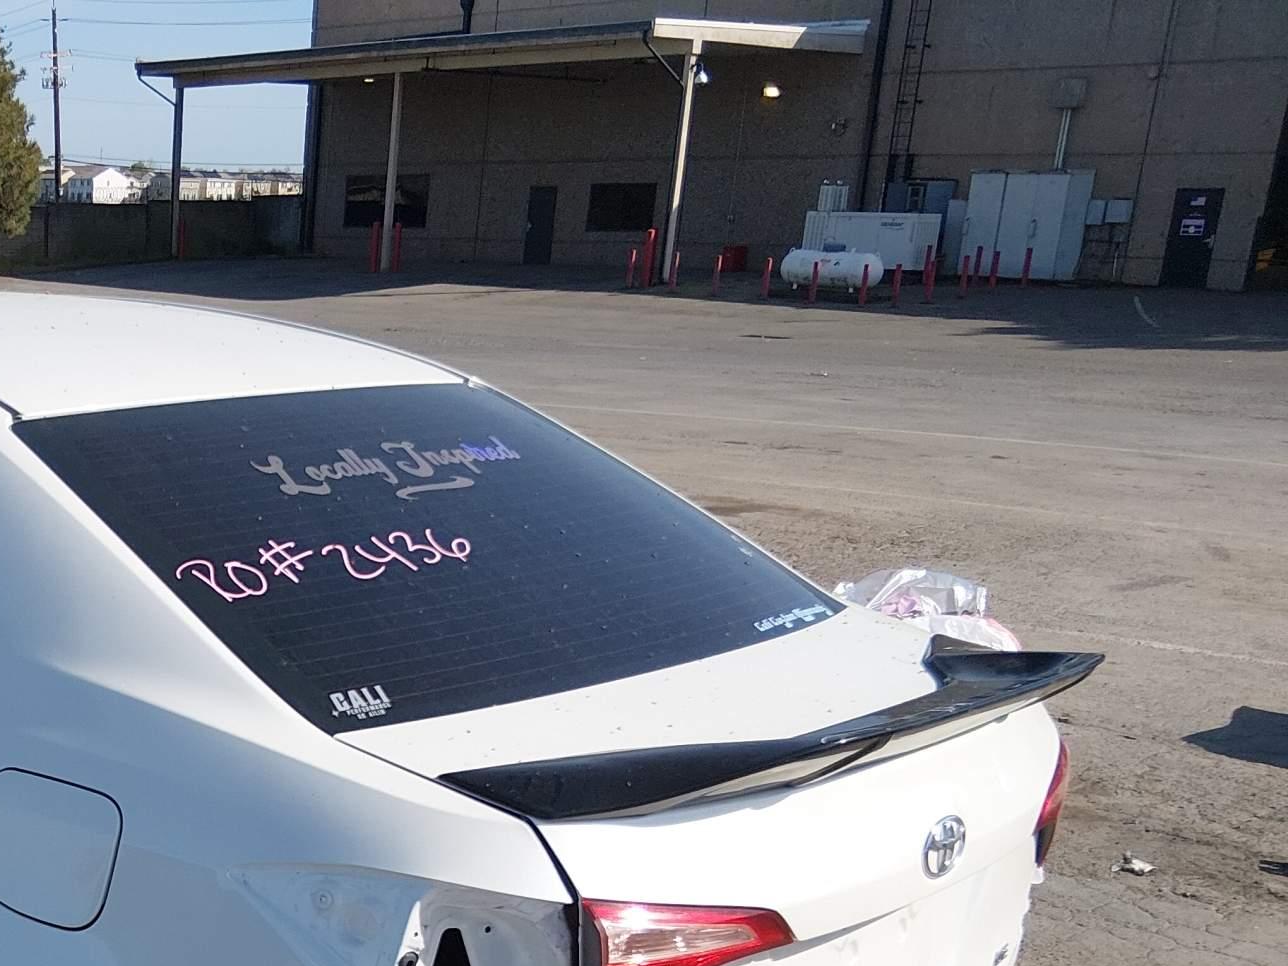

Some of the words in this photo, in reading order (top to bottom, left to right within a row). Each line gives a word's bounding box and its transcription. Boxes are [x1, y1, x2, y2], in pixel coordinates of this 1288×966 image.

[249, 448, 399, 495] Locally
[380, 435, 521, 480] Inspired
[321, 528, 471, 580] 2436
[329, 685, 390, 712] CALI
